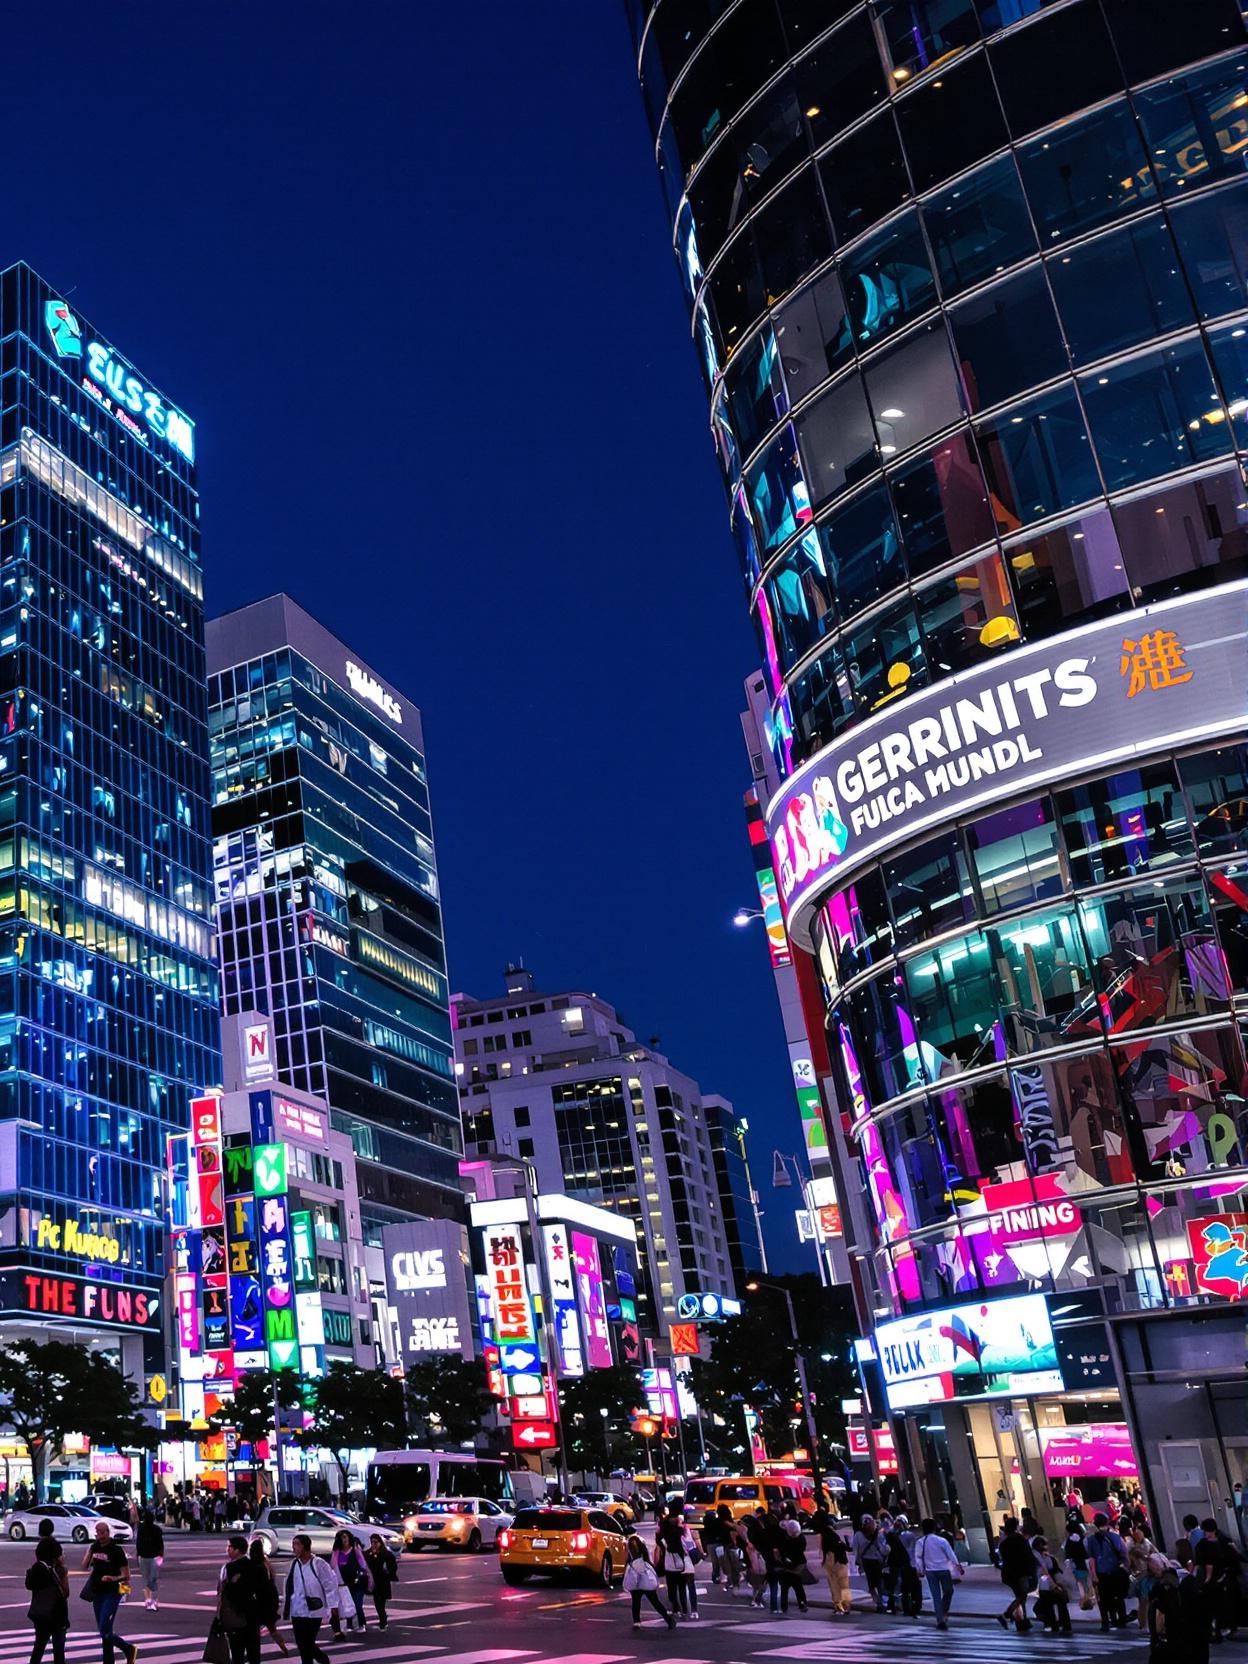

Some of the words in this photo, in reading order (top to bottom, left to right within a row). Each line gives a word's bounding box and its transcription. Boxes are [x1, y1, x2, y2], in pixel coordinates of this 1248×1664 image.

[850, 786, 926, 836] FULCA
[925, 734, 1043, 797] MUNDL
[25, 1274, 76, 1315] THE
